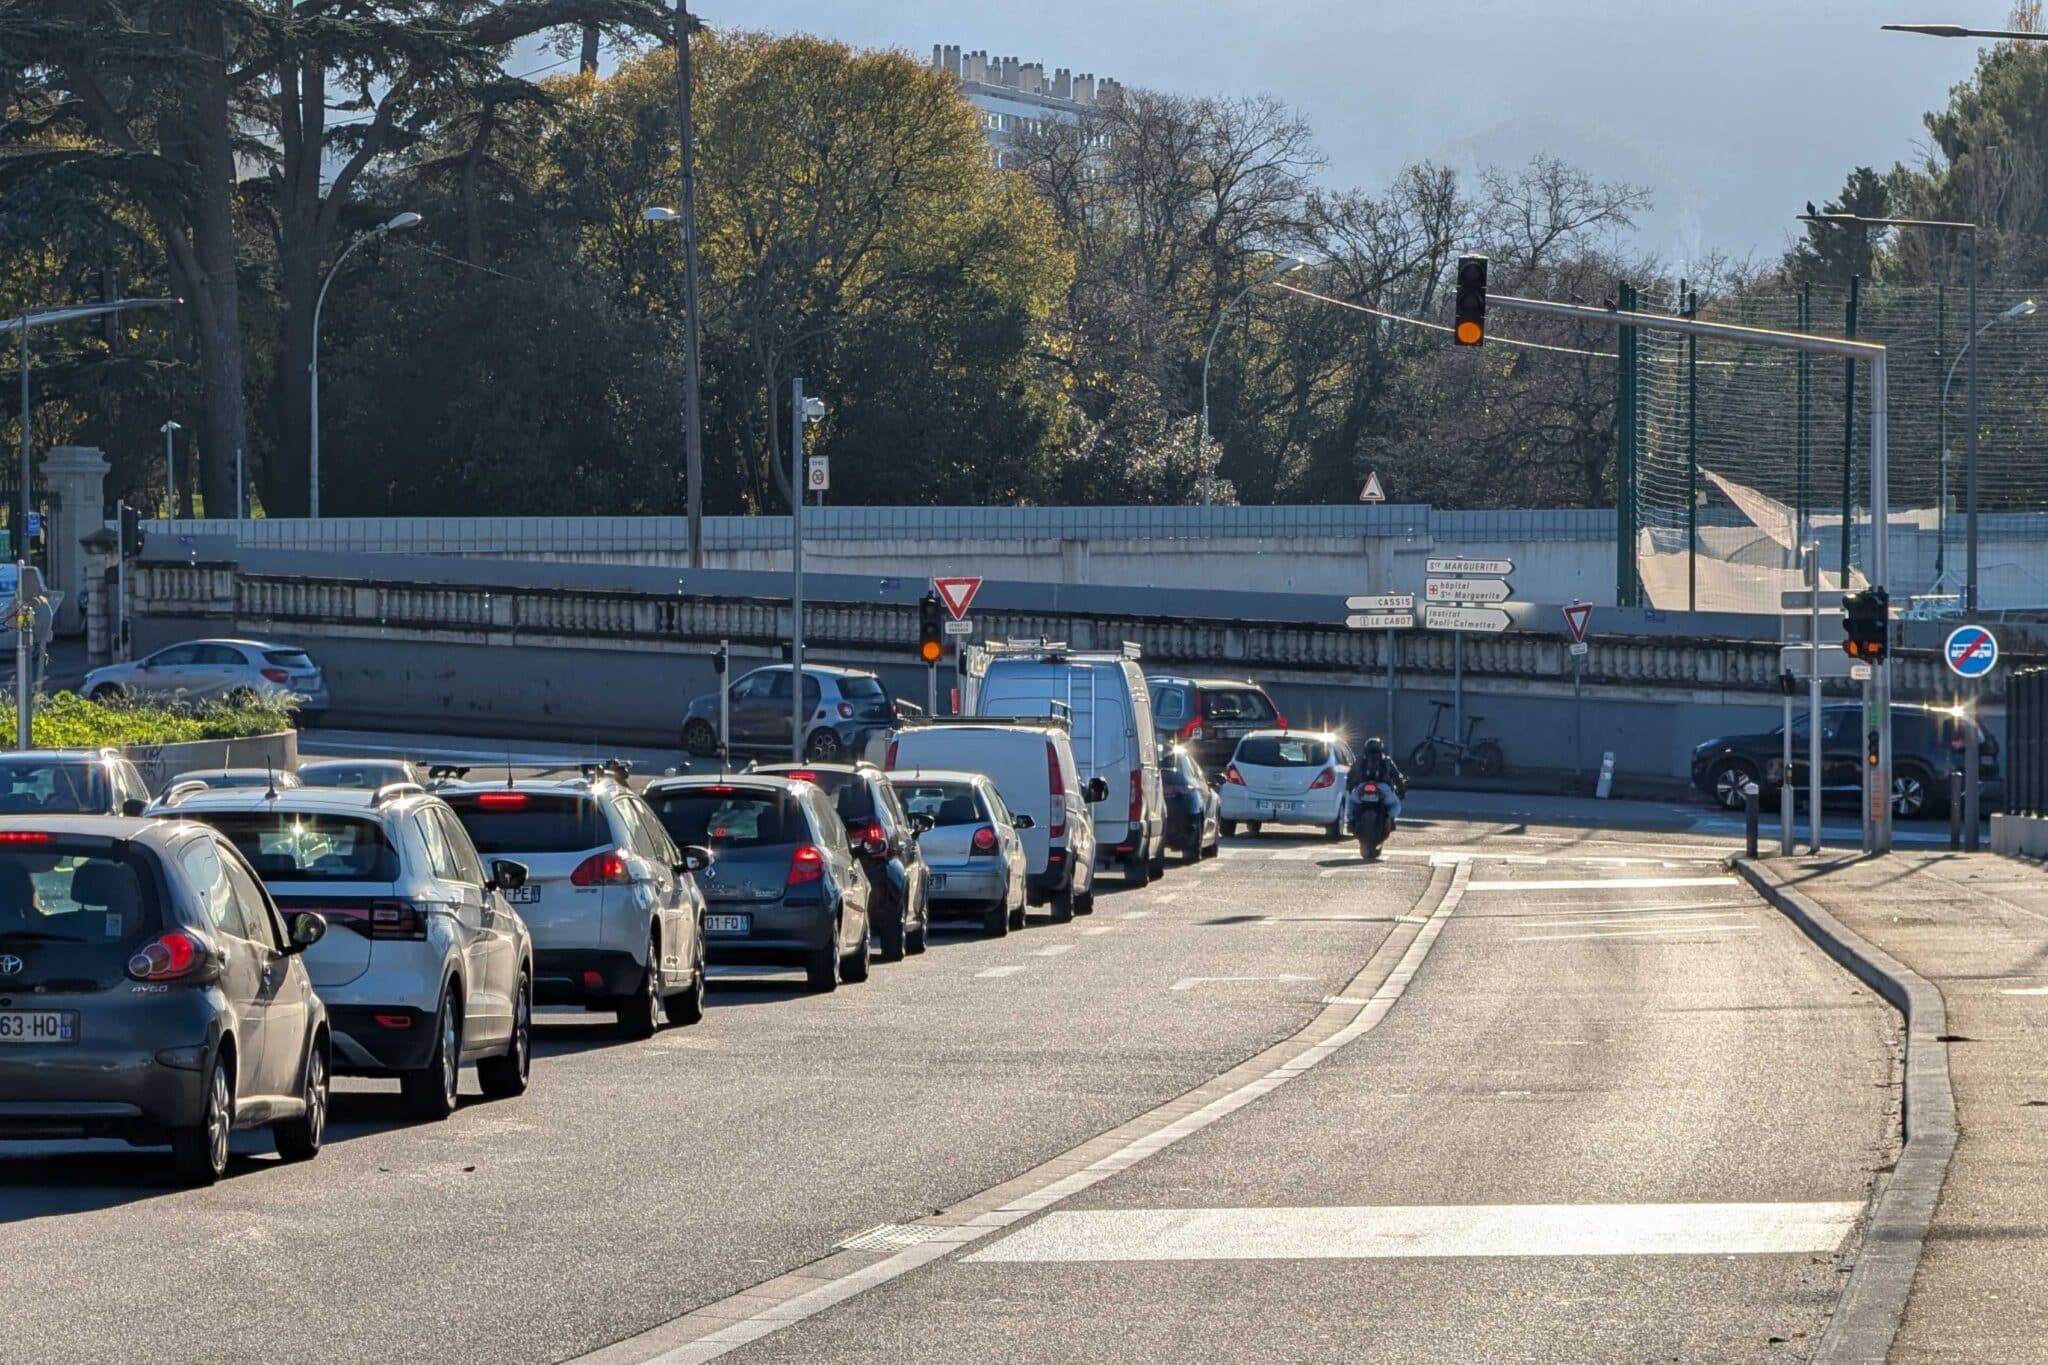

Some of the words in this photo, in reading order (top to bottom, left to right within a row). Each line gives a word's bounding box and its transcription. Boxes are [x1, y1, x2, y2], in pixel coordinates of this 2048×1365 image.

[1445, 562, 1499, 571] MARGUERITE
[1440, 581, 1470, 590] hôpital
[1455, 591, 1500, 601] Marguerite
[1378, 598, 1411, 606] CASSIS
[1370, 617, 1380, 625] LE
[1383, 616, 1411, 625] CABOT
